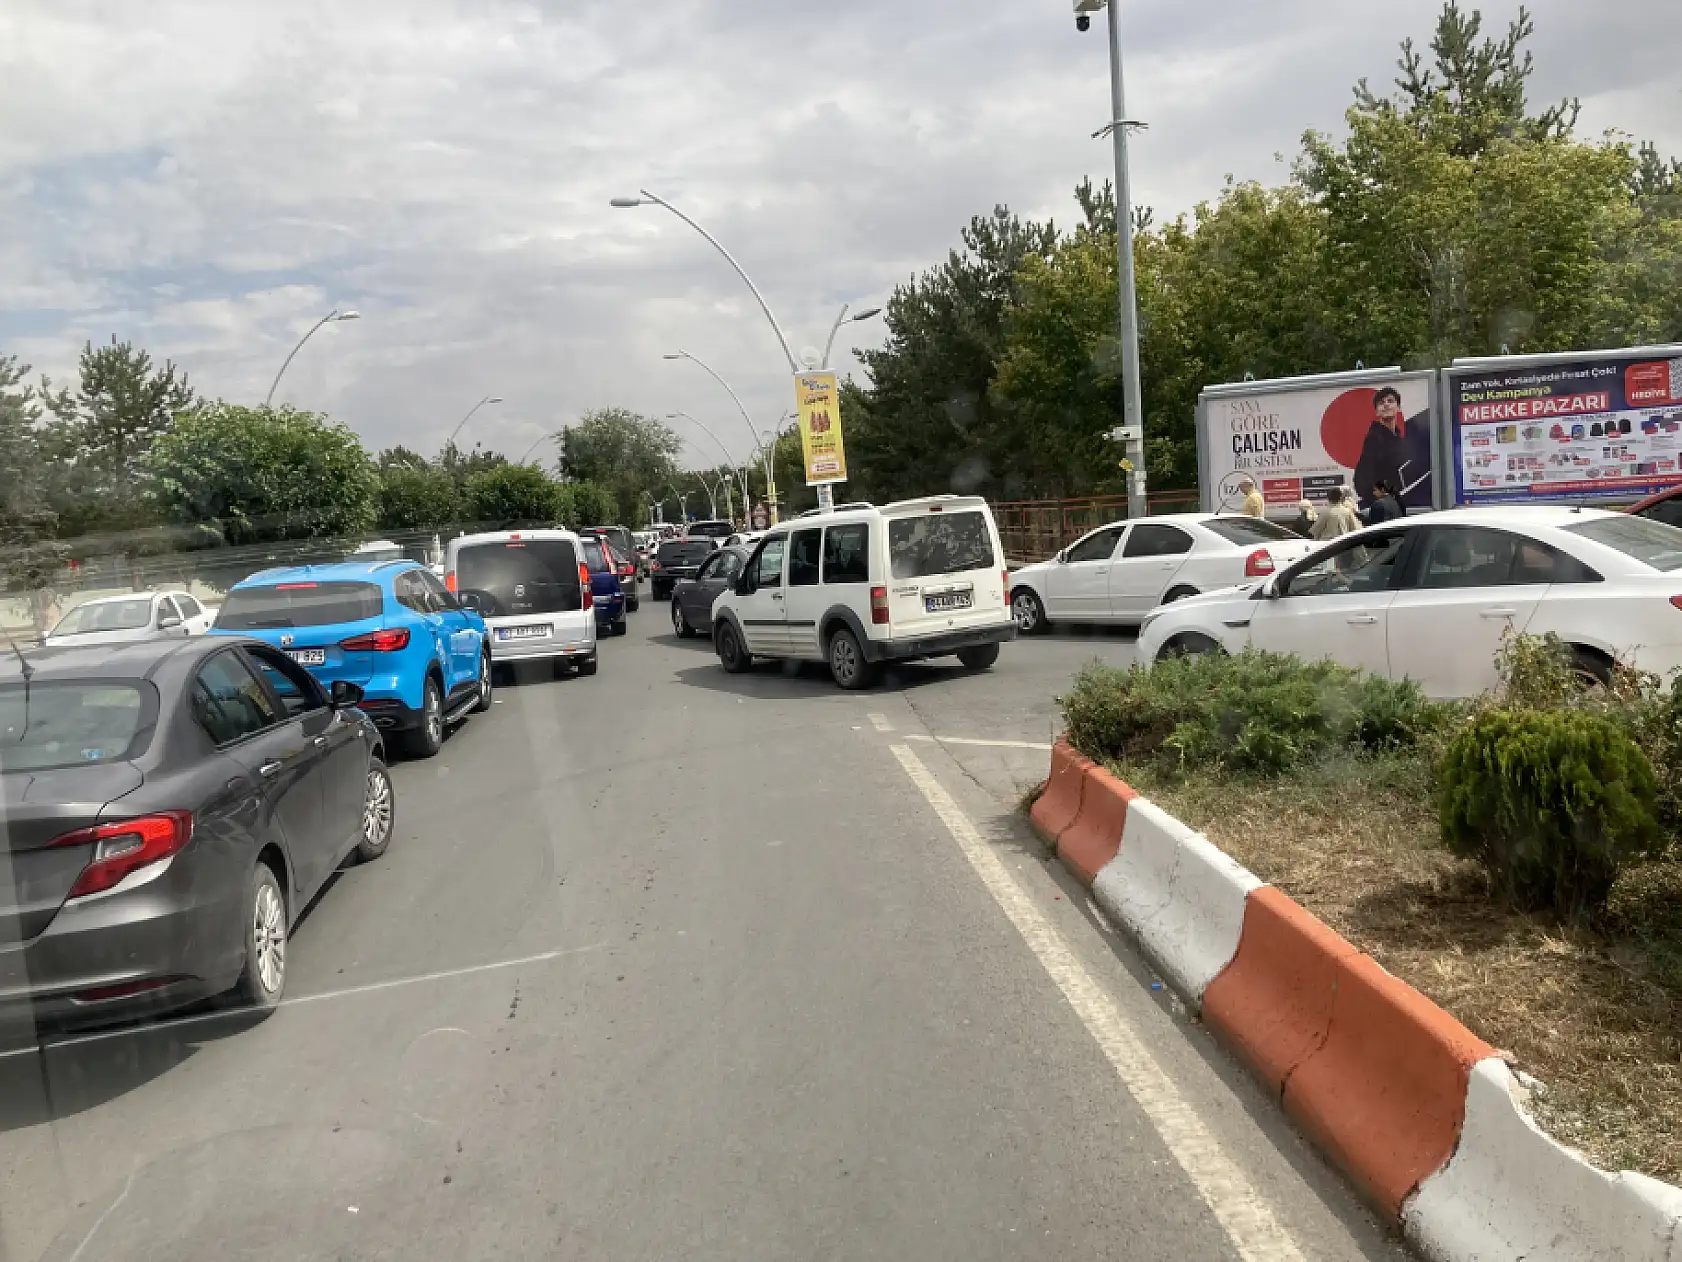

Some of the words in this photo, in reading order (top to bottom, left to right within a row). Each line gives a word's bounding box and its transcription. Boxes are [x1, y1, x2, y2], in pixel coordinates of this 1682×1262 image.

[1462, 392, 1483, 401] Dev
[1486, 386, 1551, 400] Kampanya
[1231, 401, 1260, 413] SANA
[1464, 402, 1528, 421] MEKKE
[1532, 394, 1606, 415] PAZARI
[1231, 413, 1279, 431] GÖRE
[1232, 429, 1301, 456] ÇALIŞAN
